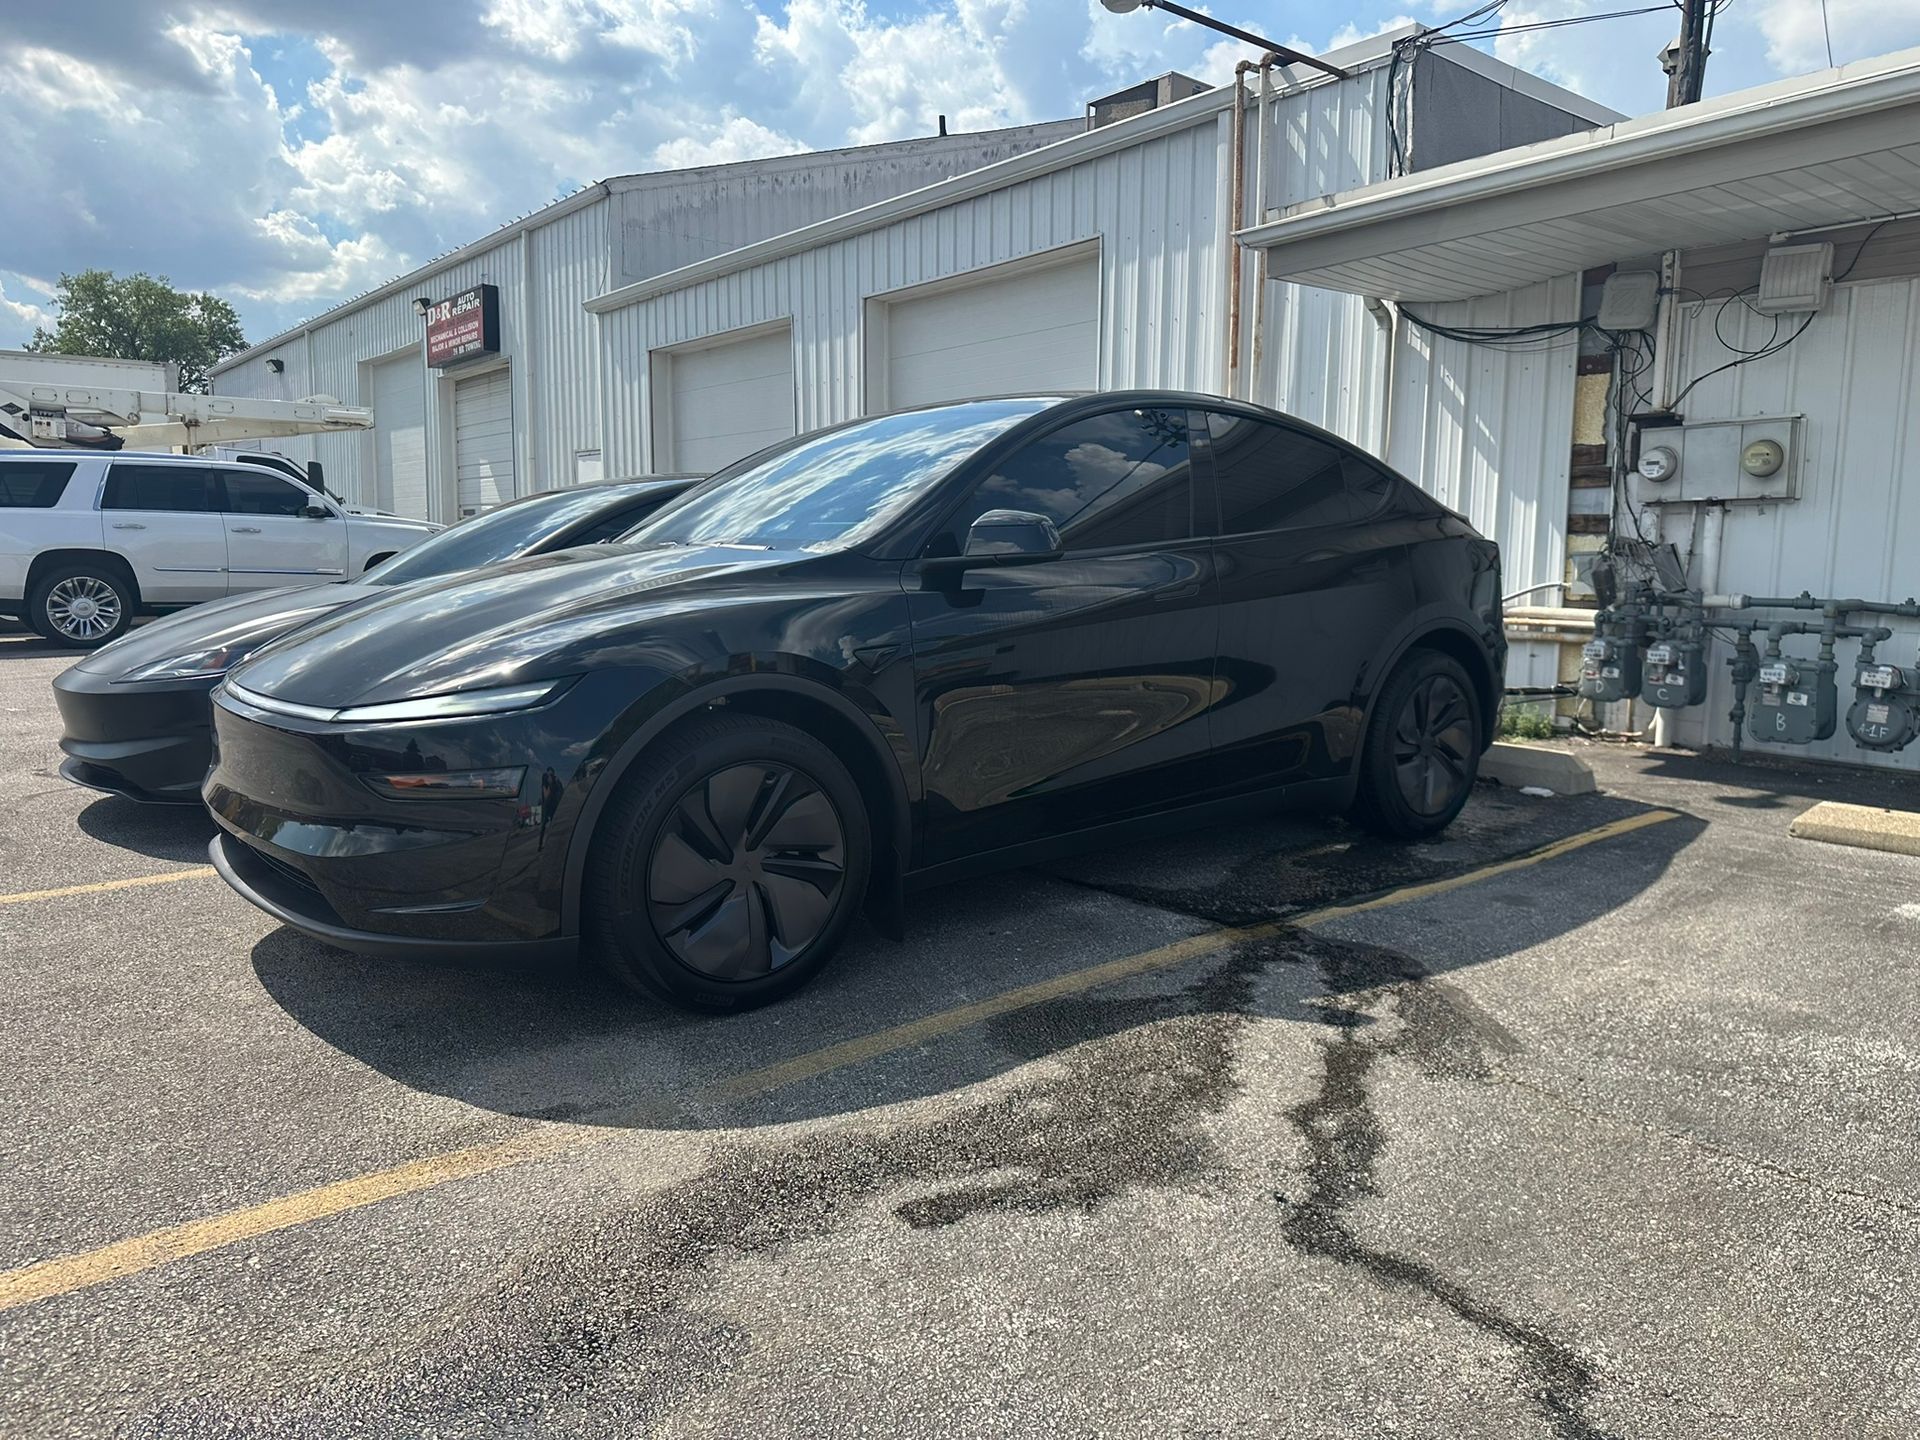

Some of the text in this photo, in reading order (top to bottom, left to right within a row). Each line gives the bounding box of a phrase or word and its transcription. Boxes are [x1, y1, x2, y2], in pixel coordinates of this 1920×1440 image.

[452, 298, 480, 316] REPAIR
[457, 292, 475, 305] AUTO
[430, 331, 453, 343] MECHANICAL
[458, 320, 479, 334] COLLISION
[432, 342, 445, 353] MAJOR
[448, 336, 461, 348] MINOR
[461, 331, 478, 342] REPAIRS
[465, 340, 481, 351] TOWING
[1595, 680, 1604, 693] D
[1657, 688, 1669, 700] C
[1776, 712, 1786, 731] B
[620, 773, 676, 898] SCORPION MS
